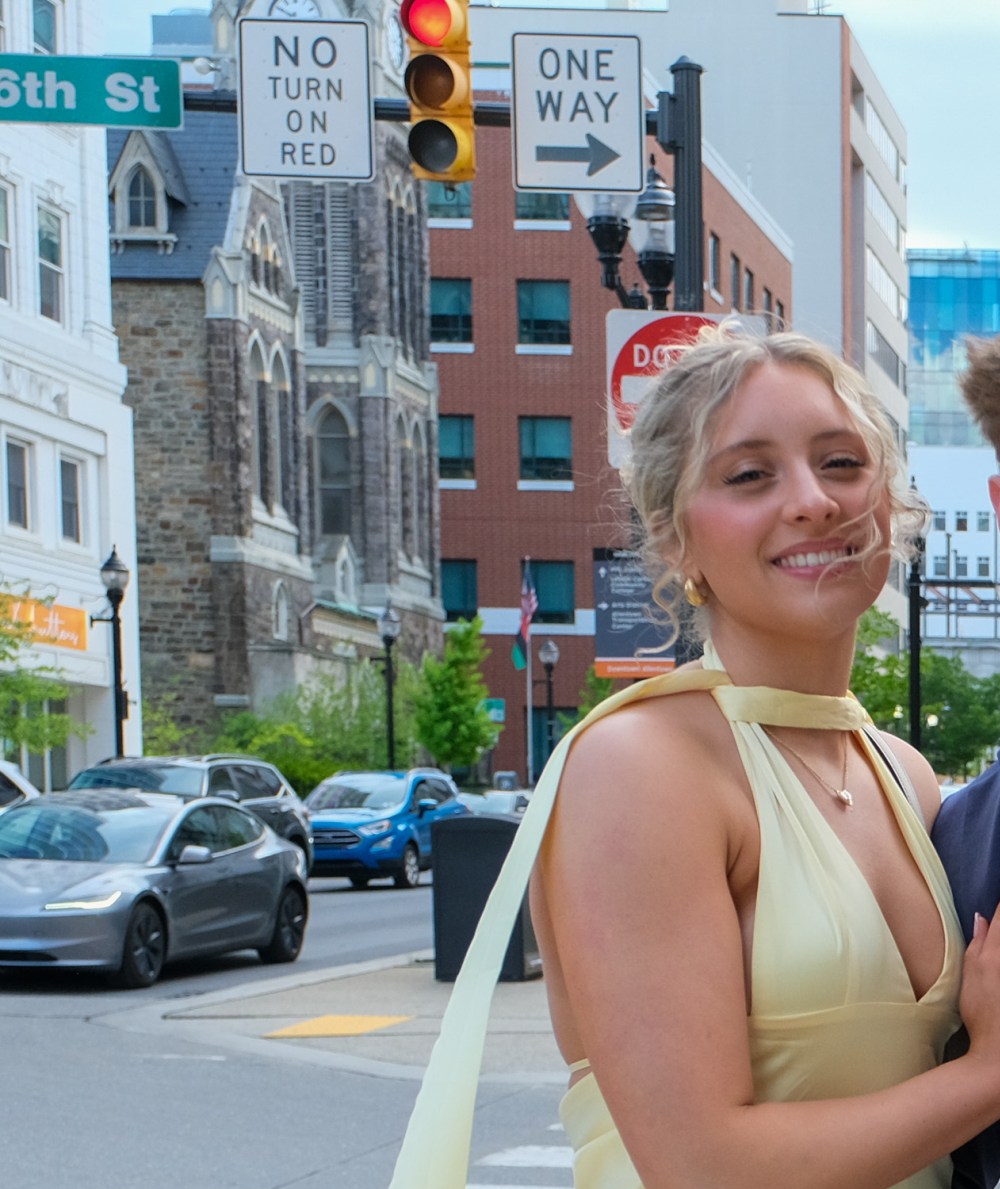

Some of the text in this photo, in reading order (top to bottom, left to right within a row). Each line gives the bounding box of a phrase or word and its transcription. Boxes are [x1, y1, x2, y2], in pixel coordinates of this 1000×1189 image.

[274, 36, 337, 68] NO
[539, 48, 615, 81] ONE
[105, 72, 161, 113] St
[268, 76, 342, 100] TURN
[287, 110, 326, 133] ON
[536, 90, 618, 123] WAY
[282, 142, 336, 166] RED
